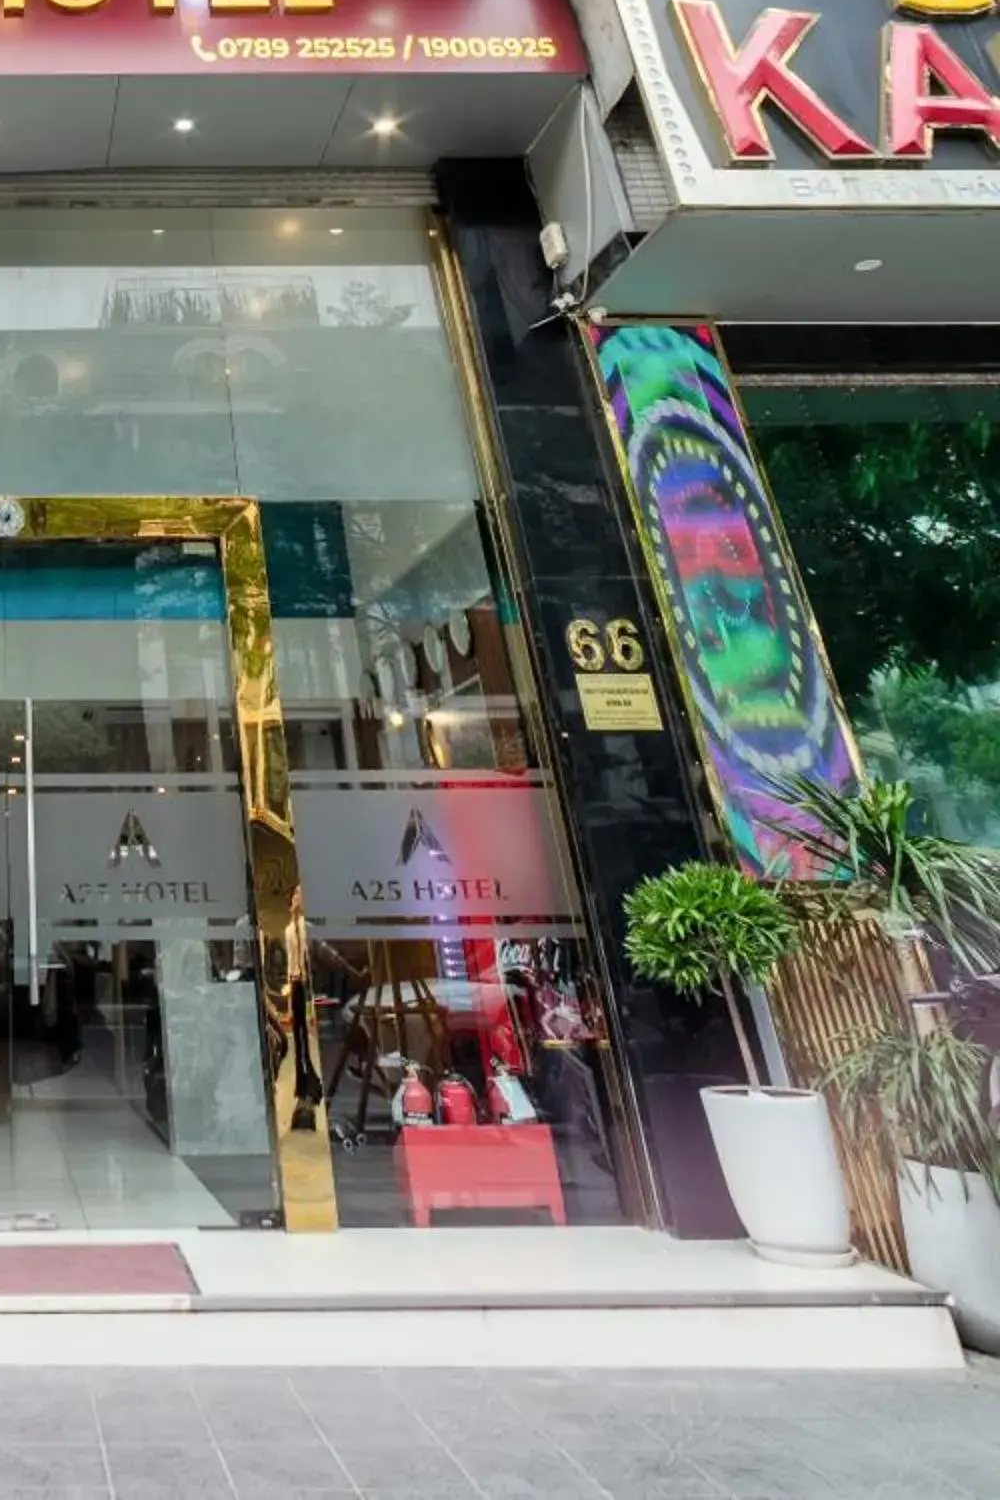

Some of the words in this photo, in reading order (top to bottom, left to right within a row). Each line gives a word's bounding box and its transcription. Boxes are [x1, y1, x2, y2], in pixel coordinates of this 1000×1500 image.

[218, 36, 289, 59] 0789
[296, 36, 396, 59] 252525
[417, 36, 556, 59] 19006925
[566, 618, 644, 671] 66
[348, 879, 402, 901] A25
[413, 878, 511, 901] HOTEL
